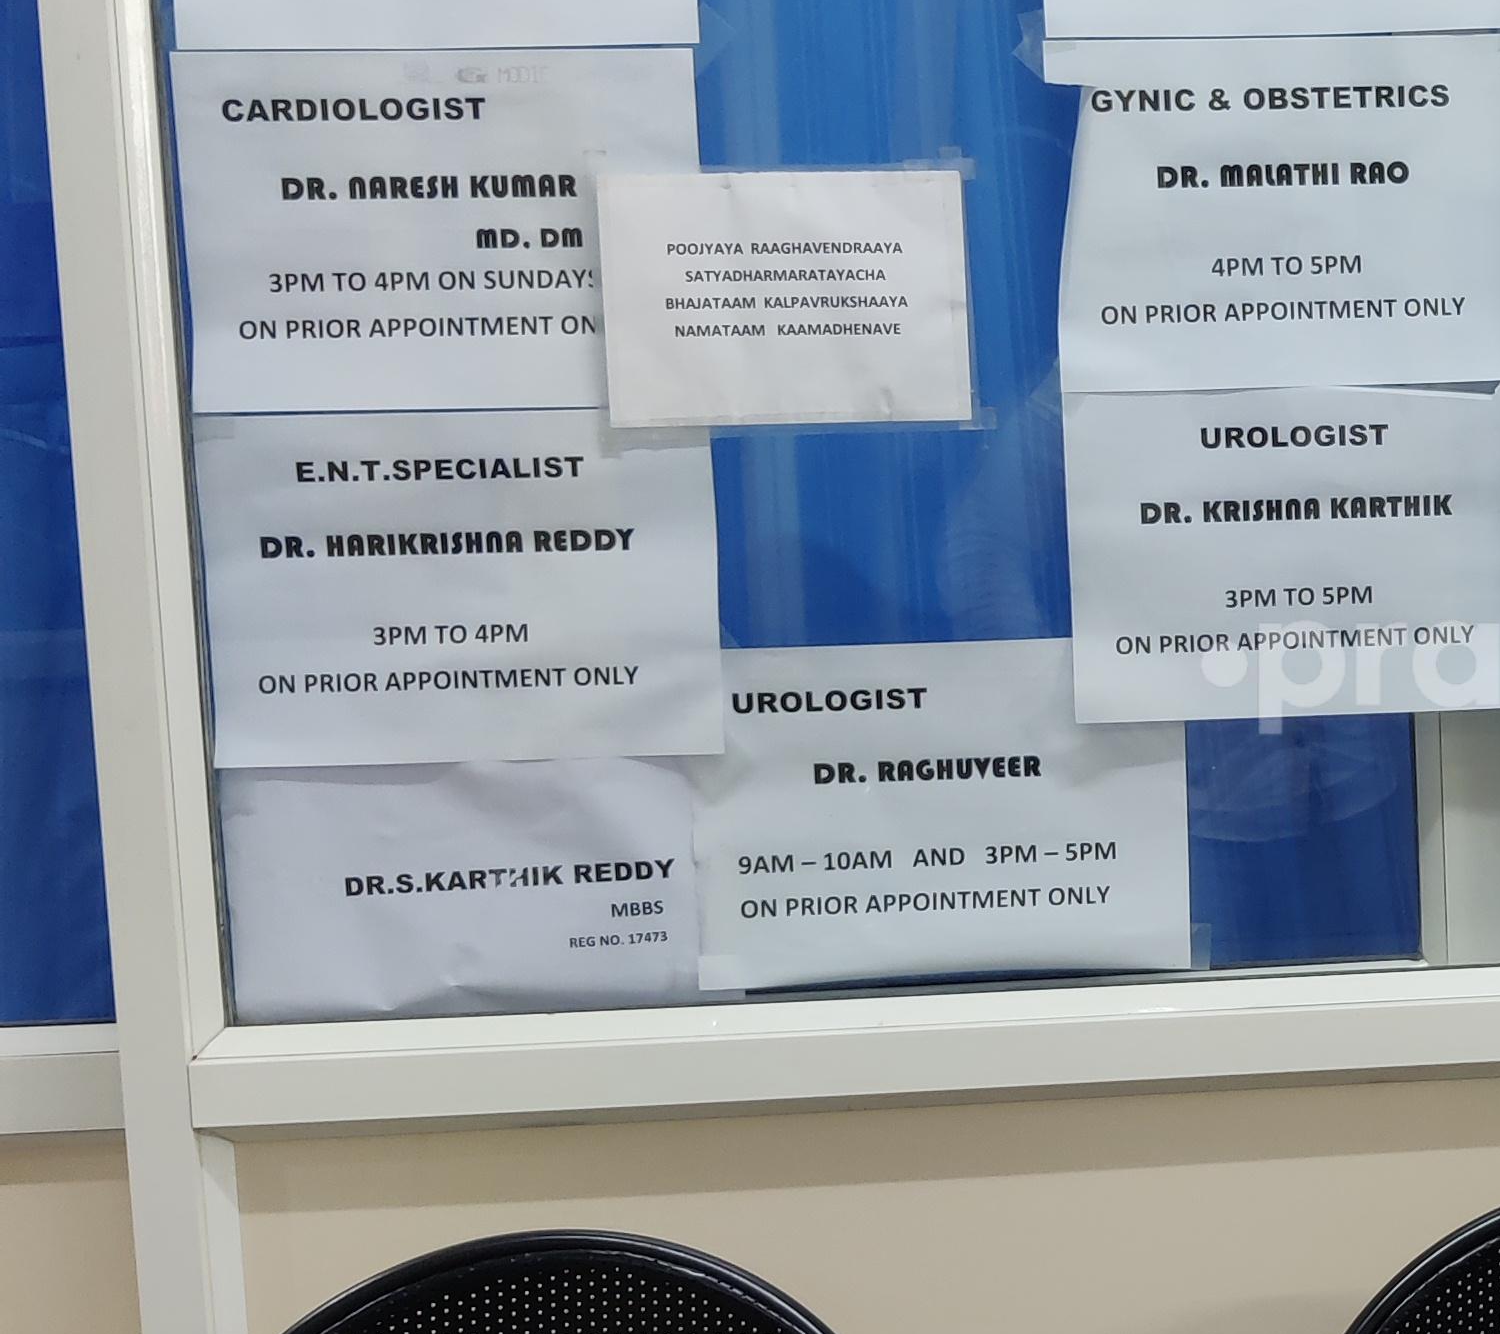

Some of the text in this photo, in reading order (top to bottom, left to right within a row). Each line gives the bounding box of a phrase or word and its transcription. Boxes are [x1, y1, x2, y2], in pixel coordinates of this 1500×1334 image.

[222, 98, 485, 122] CARDIOLOGIST
[1092, 85, 1449, 112] GYNIC & OBSTETRICS
[1157, 161, 1409, 188] DR. MALATHI RAO
[281, 175, 577, 200] DR. NARESH KUMAR
[477, 228, 583, 248] MD. DM
[667, 242, 902, 255] POOJYAYA RAAGHAVENDRAAYA
[686, 269, 886, 282] SATYADHARMARATAYACHA
[1212, 255, 1361, 276] 4PM TO 5PM
[270, 273, 324, 292] 3PM
[332, 273, 366, 291] TO
[375, 272, 429, 291] 4PM
[439, 271, 475, 290] ON
[666, 296, 908, 309] BHAJATAAM KALPAVRUKSHAAYA
[675, 323, 901, 337] NAMATAAM KAAMADHENAVE
[1201, 424, 1388, 448] UROLOGIST
[1141, 494, 1452, 524] DR. KRISHNA KARTHIK
[260, 529, 634, 558] DR. HARIKRISHNA REDDY
[1226, 586, 1372, 608] 3PM TO 5PM
[374, 624, 527, 645] 3PM TO 4PM
[1116, 625, 1474, 654] ON PRIOR APPOINTMENT ONLY
[732, 688, 927, 713] UROLOGIST
[814, 756, 1041, 784] DR. RAGHUVEER
[574, 859, 674, 883] REDDY
[611, 901, 663, 917] MBBS
[741, 886, 1110, 918] ON PRIOR APPOINTMENT ONLY
[570, 931, 667, 948] REG NO. 17473
